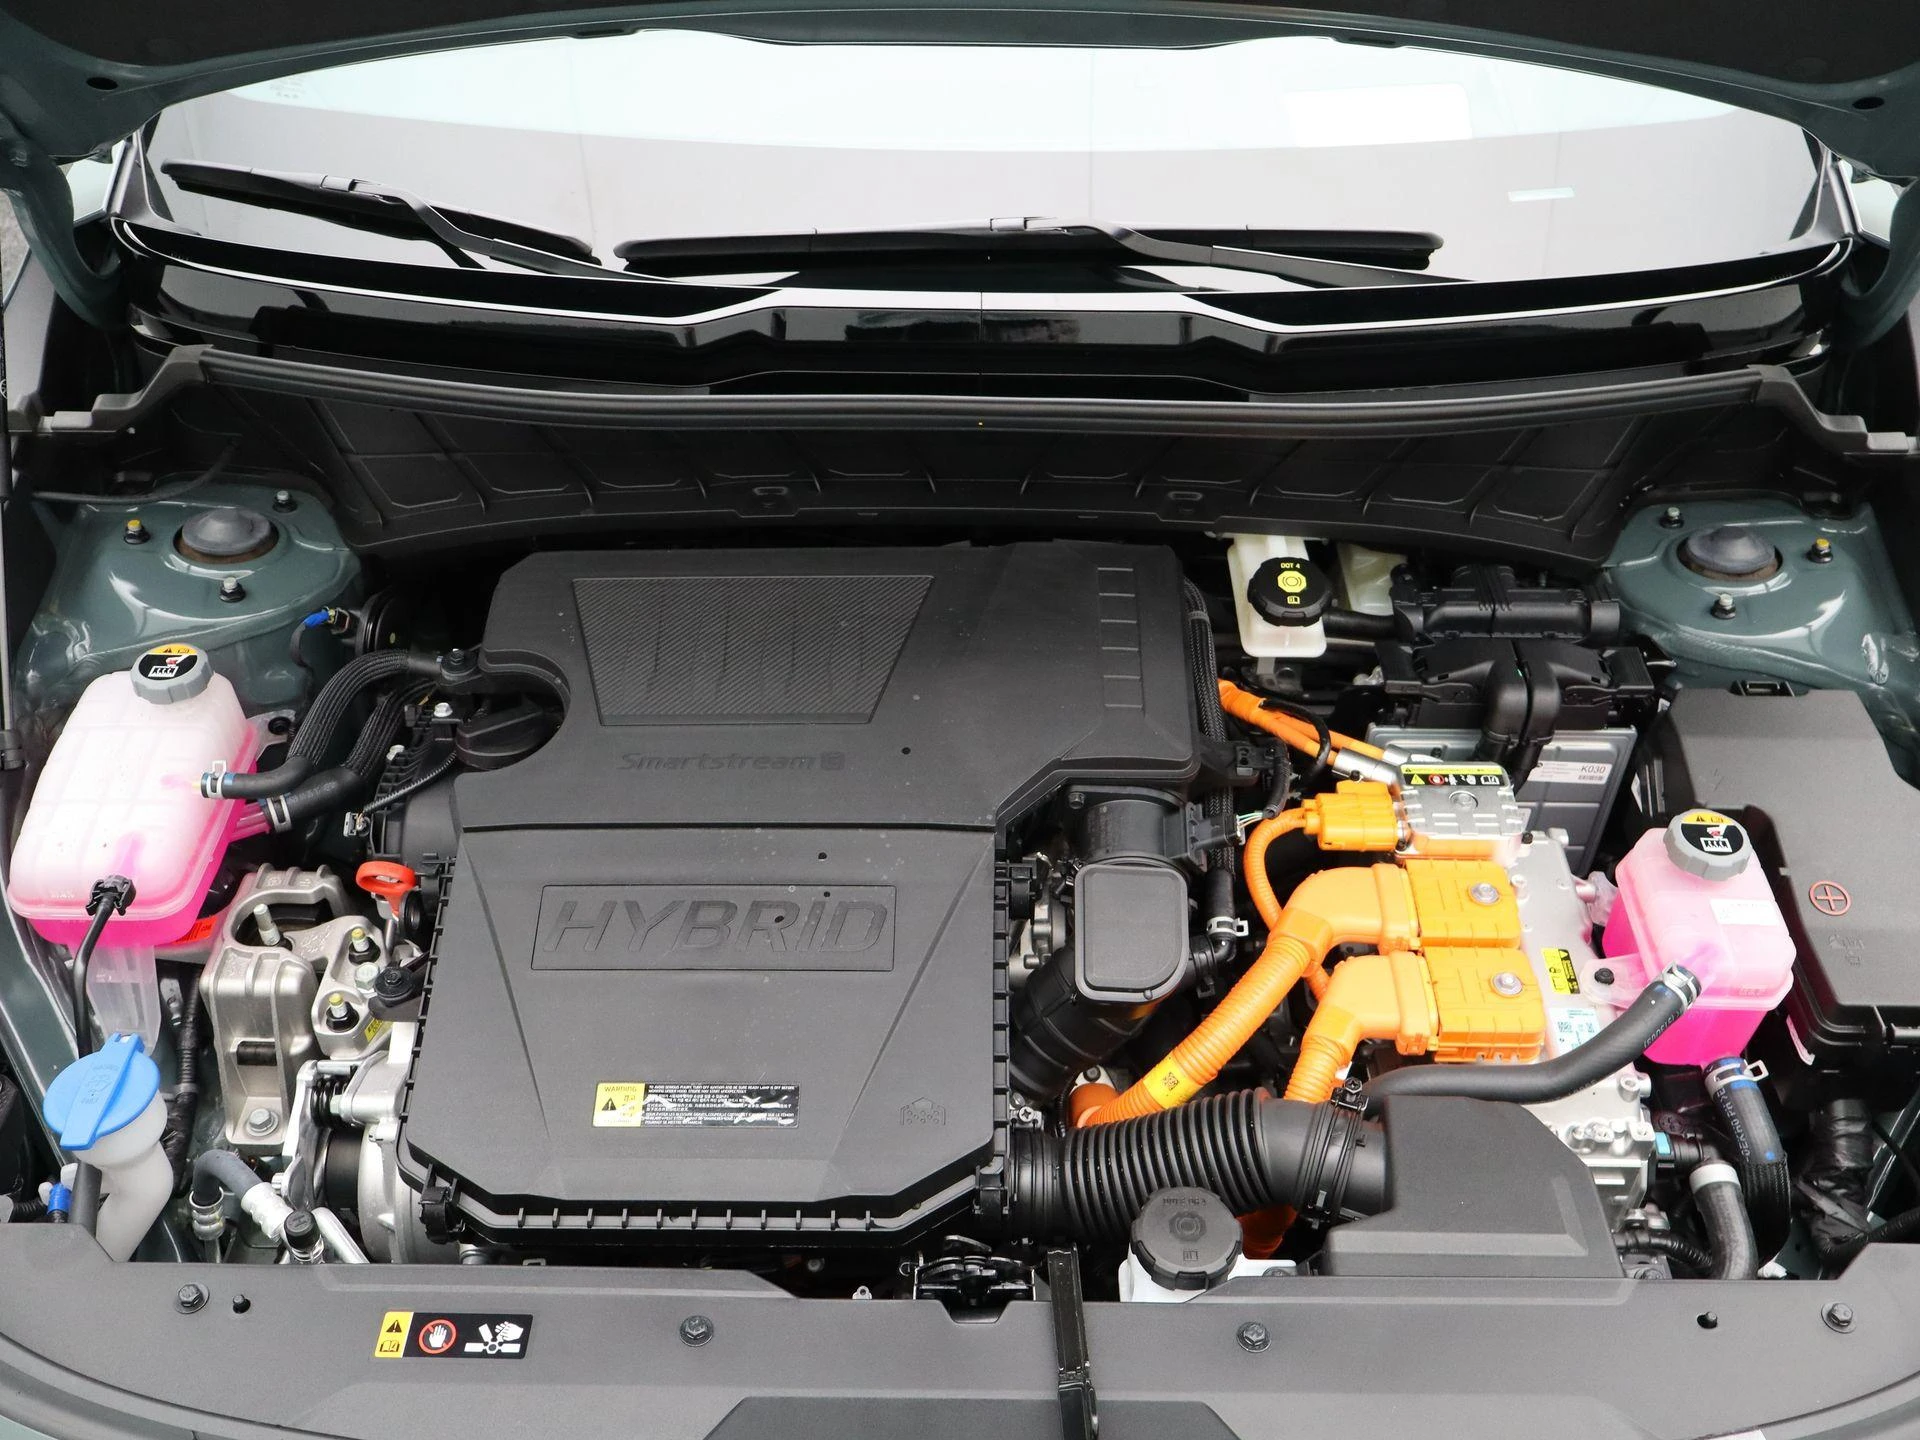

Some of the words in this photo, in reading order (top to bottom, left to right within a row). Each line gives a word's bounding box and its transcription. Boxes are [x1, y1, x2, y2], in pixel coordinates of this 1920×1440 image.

[616, 753, 816, 770] Smartstream
[1581, 765, 1606, 774] K030
[544, 900, 887, 951] HYBRID
